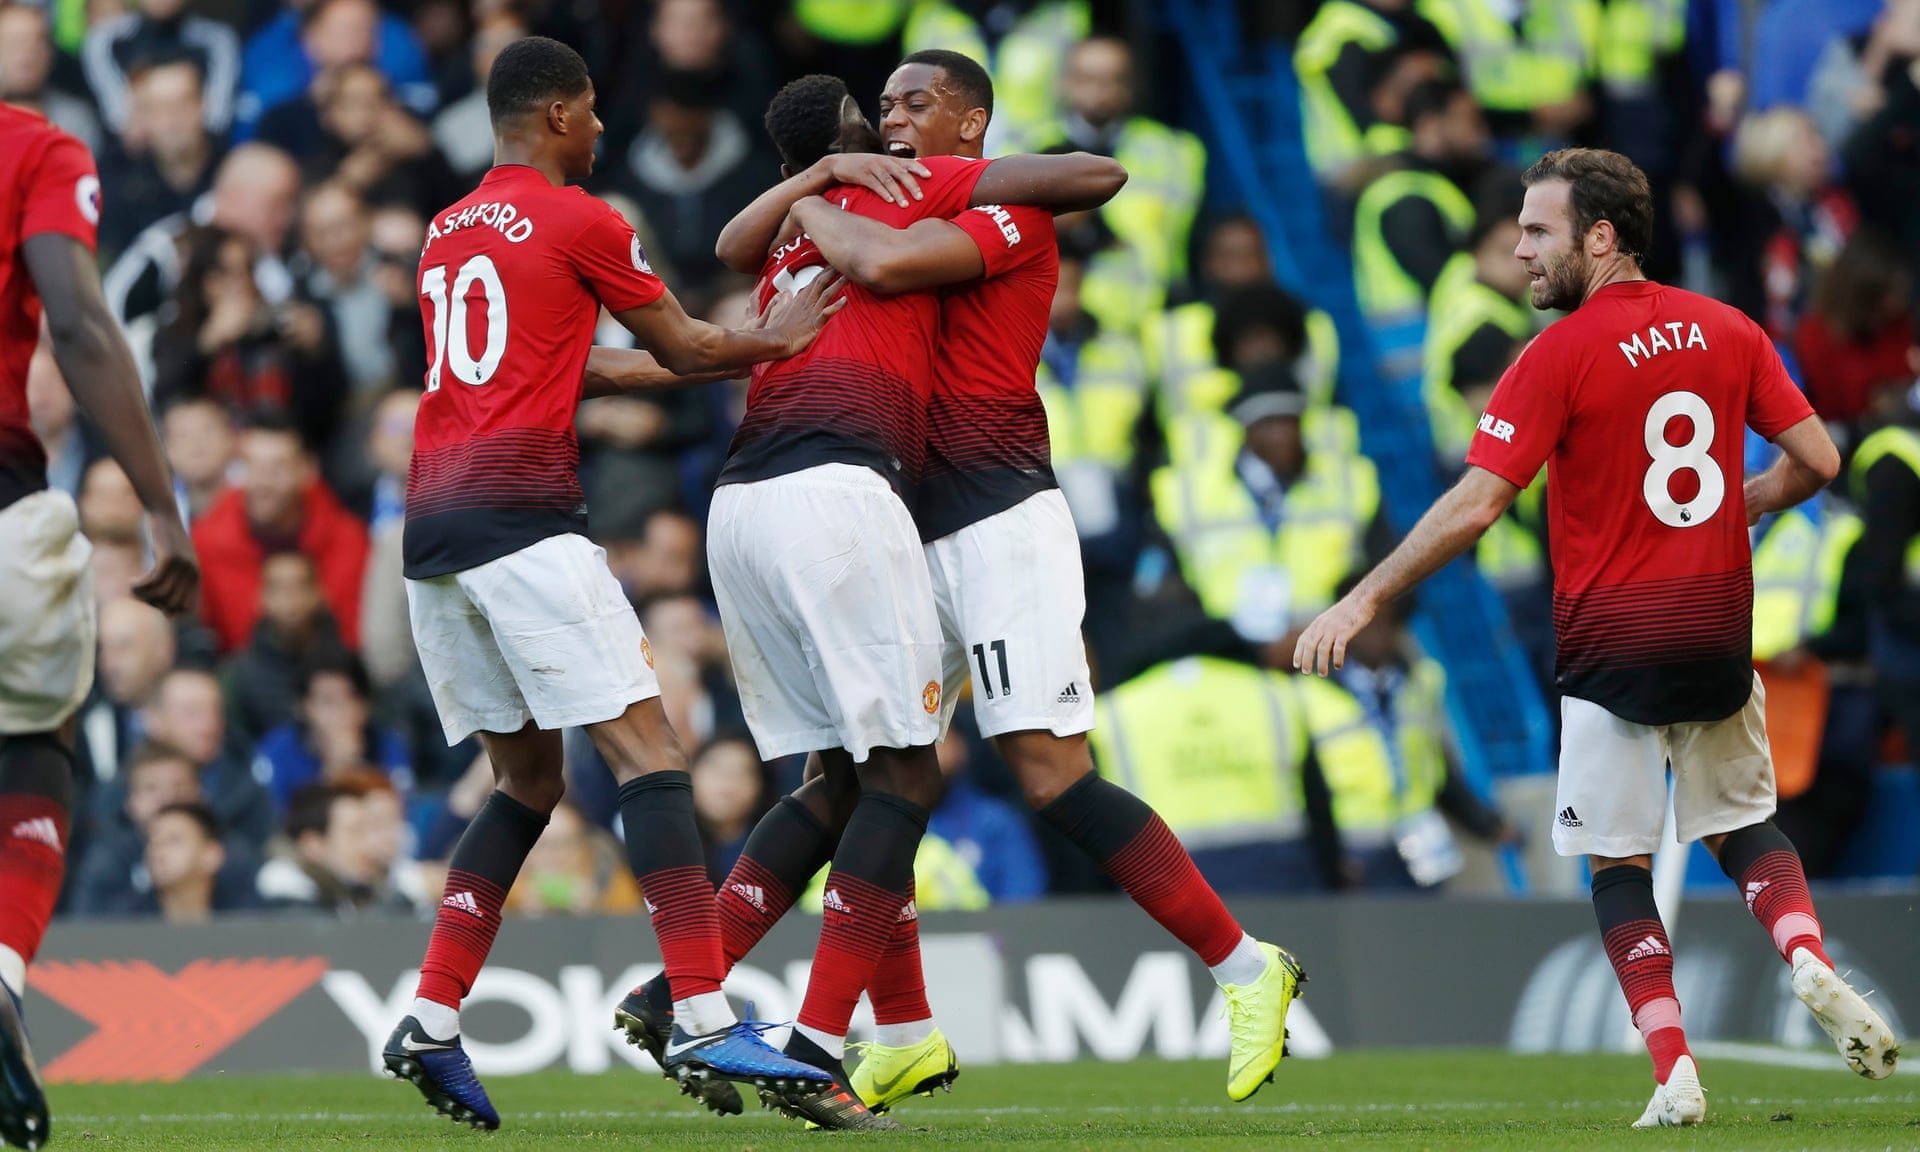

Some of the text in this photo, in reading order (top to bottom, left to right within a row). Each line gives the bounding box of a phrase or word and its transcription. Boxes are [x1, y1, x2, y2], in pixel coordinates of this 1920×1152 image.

[421, 202, 534, 258] ASHFORD
[421, 254, 508, 393] 10
[1618, 320, 1708, 368] MATA
[1643, 390, 1725, 528] 8
[973, 639, 1011, 700] 11
[442, 898, 484, 918] adidas
[1627, 948, 1670, 961] adidas
